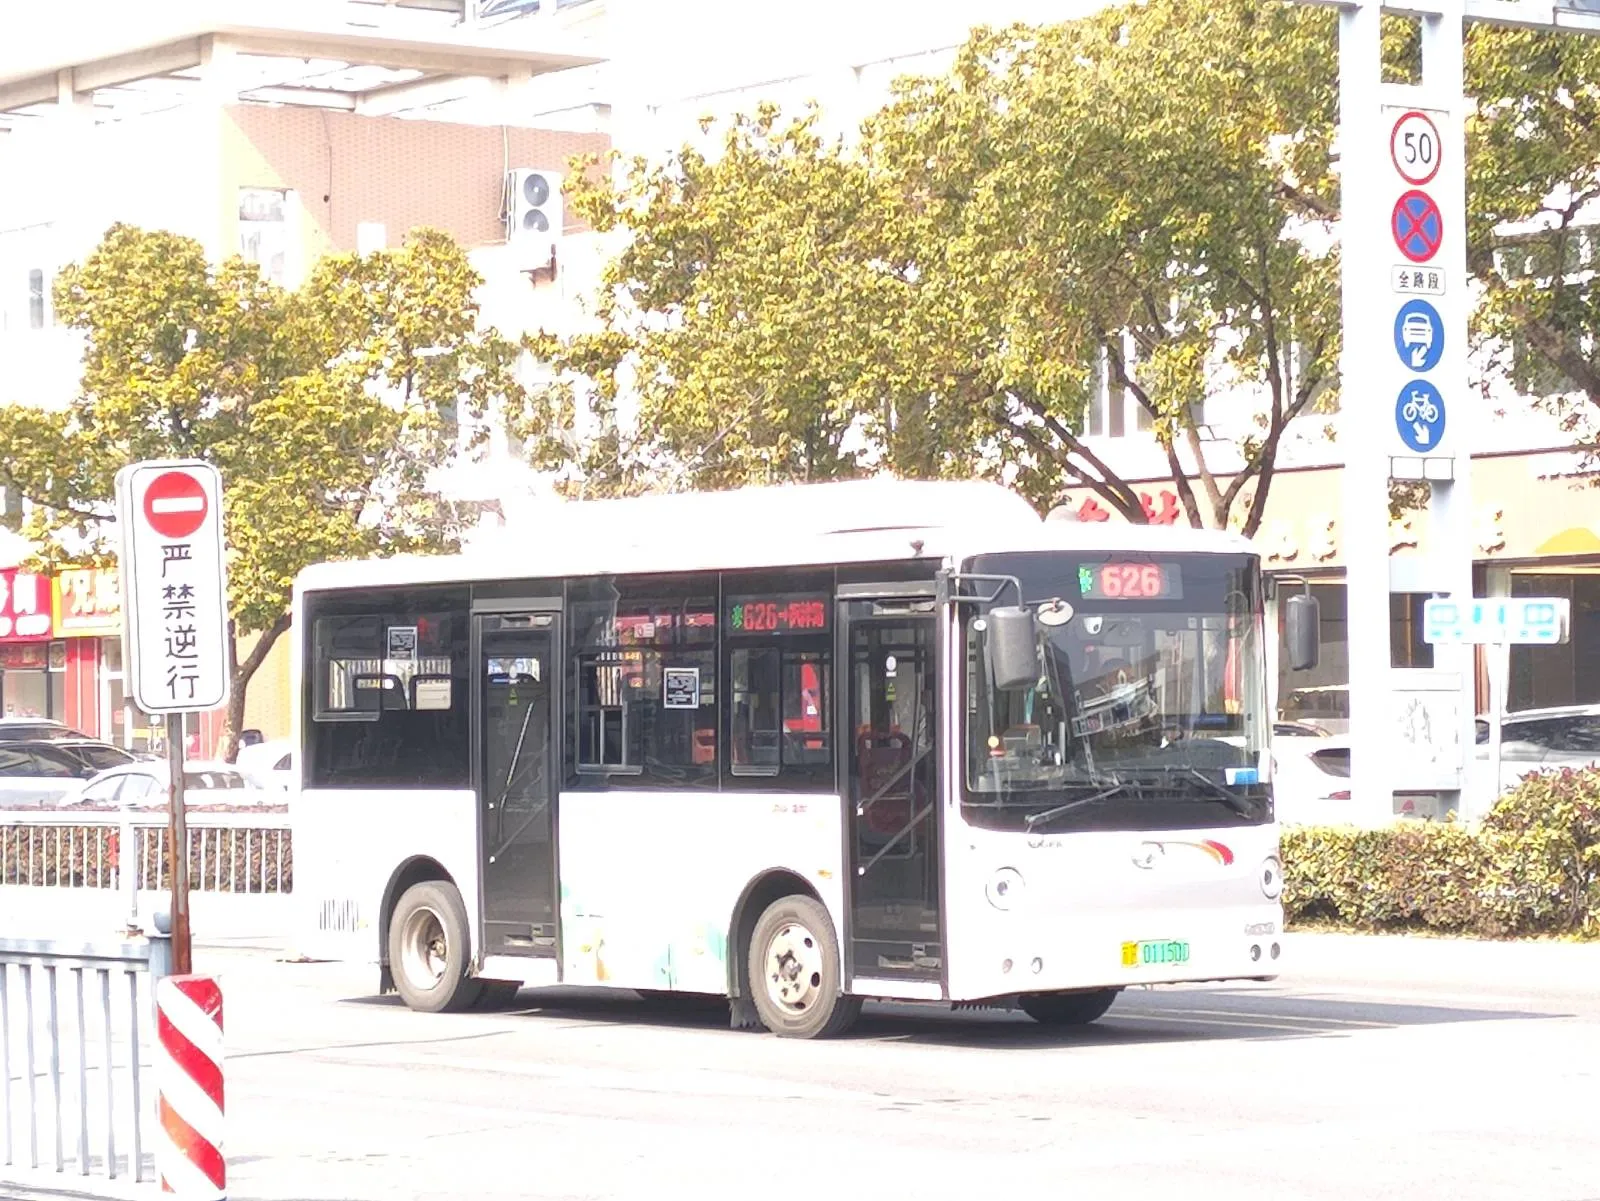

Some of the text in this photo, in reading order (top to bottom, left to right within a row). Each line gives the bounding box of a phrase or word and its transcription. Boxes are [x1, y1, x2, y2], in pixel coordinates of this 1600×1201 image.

[1404, 132, 1432, 164] 50
[1101, 565, 1162, 597] 626
[161, 543, 199, 700] 严禁逆行
[743, 603, 777, 631] 626
